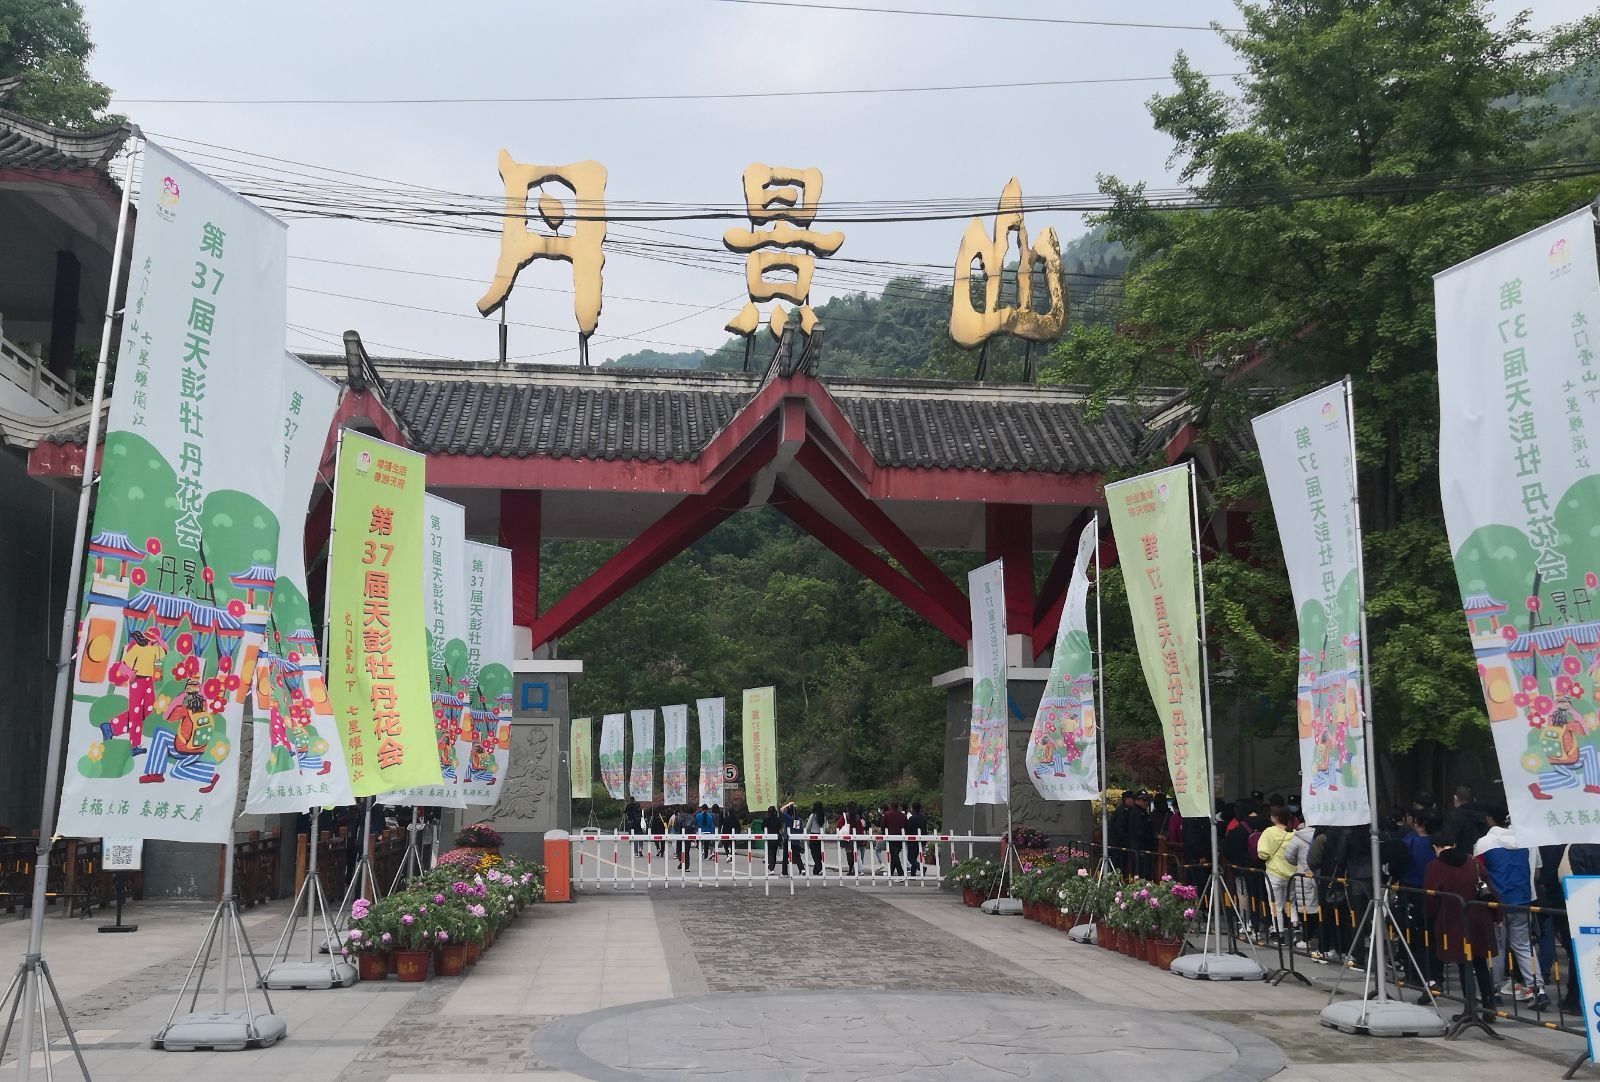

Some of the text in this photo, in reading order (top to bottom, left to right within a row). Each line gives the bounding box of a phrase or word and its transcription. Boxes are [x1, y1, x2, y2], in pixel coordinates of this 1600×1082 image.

[476, 148, 1069, 350] 丹景山
[175, 221, 227, 551] 第37届天彭牡丹花会
[361, 505, 404, 769] 第37届天彭牡丹花会
[430, 514, 446, 670] 第37届天彭牡丹花会
[467, 559, 486, 691] 第37届天彭牡丹花会
[521, 682, 549, 711] 口
[726, 767, 734, 779] 5
